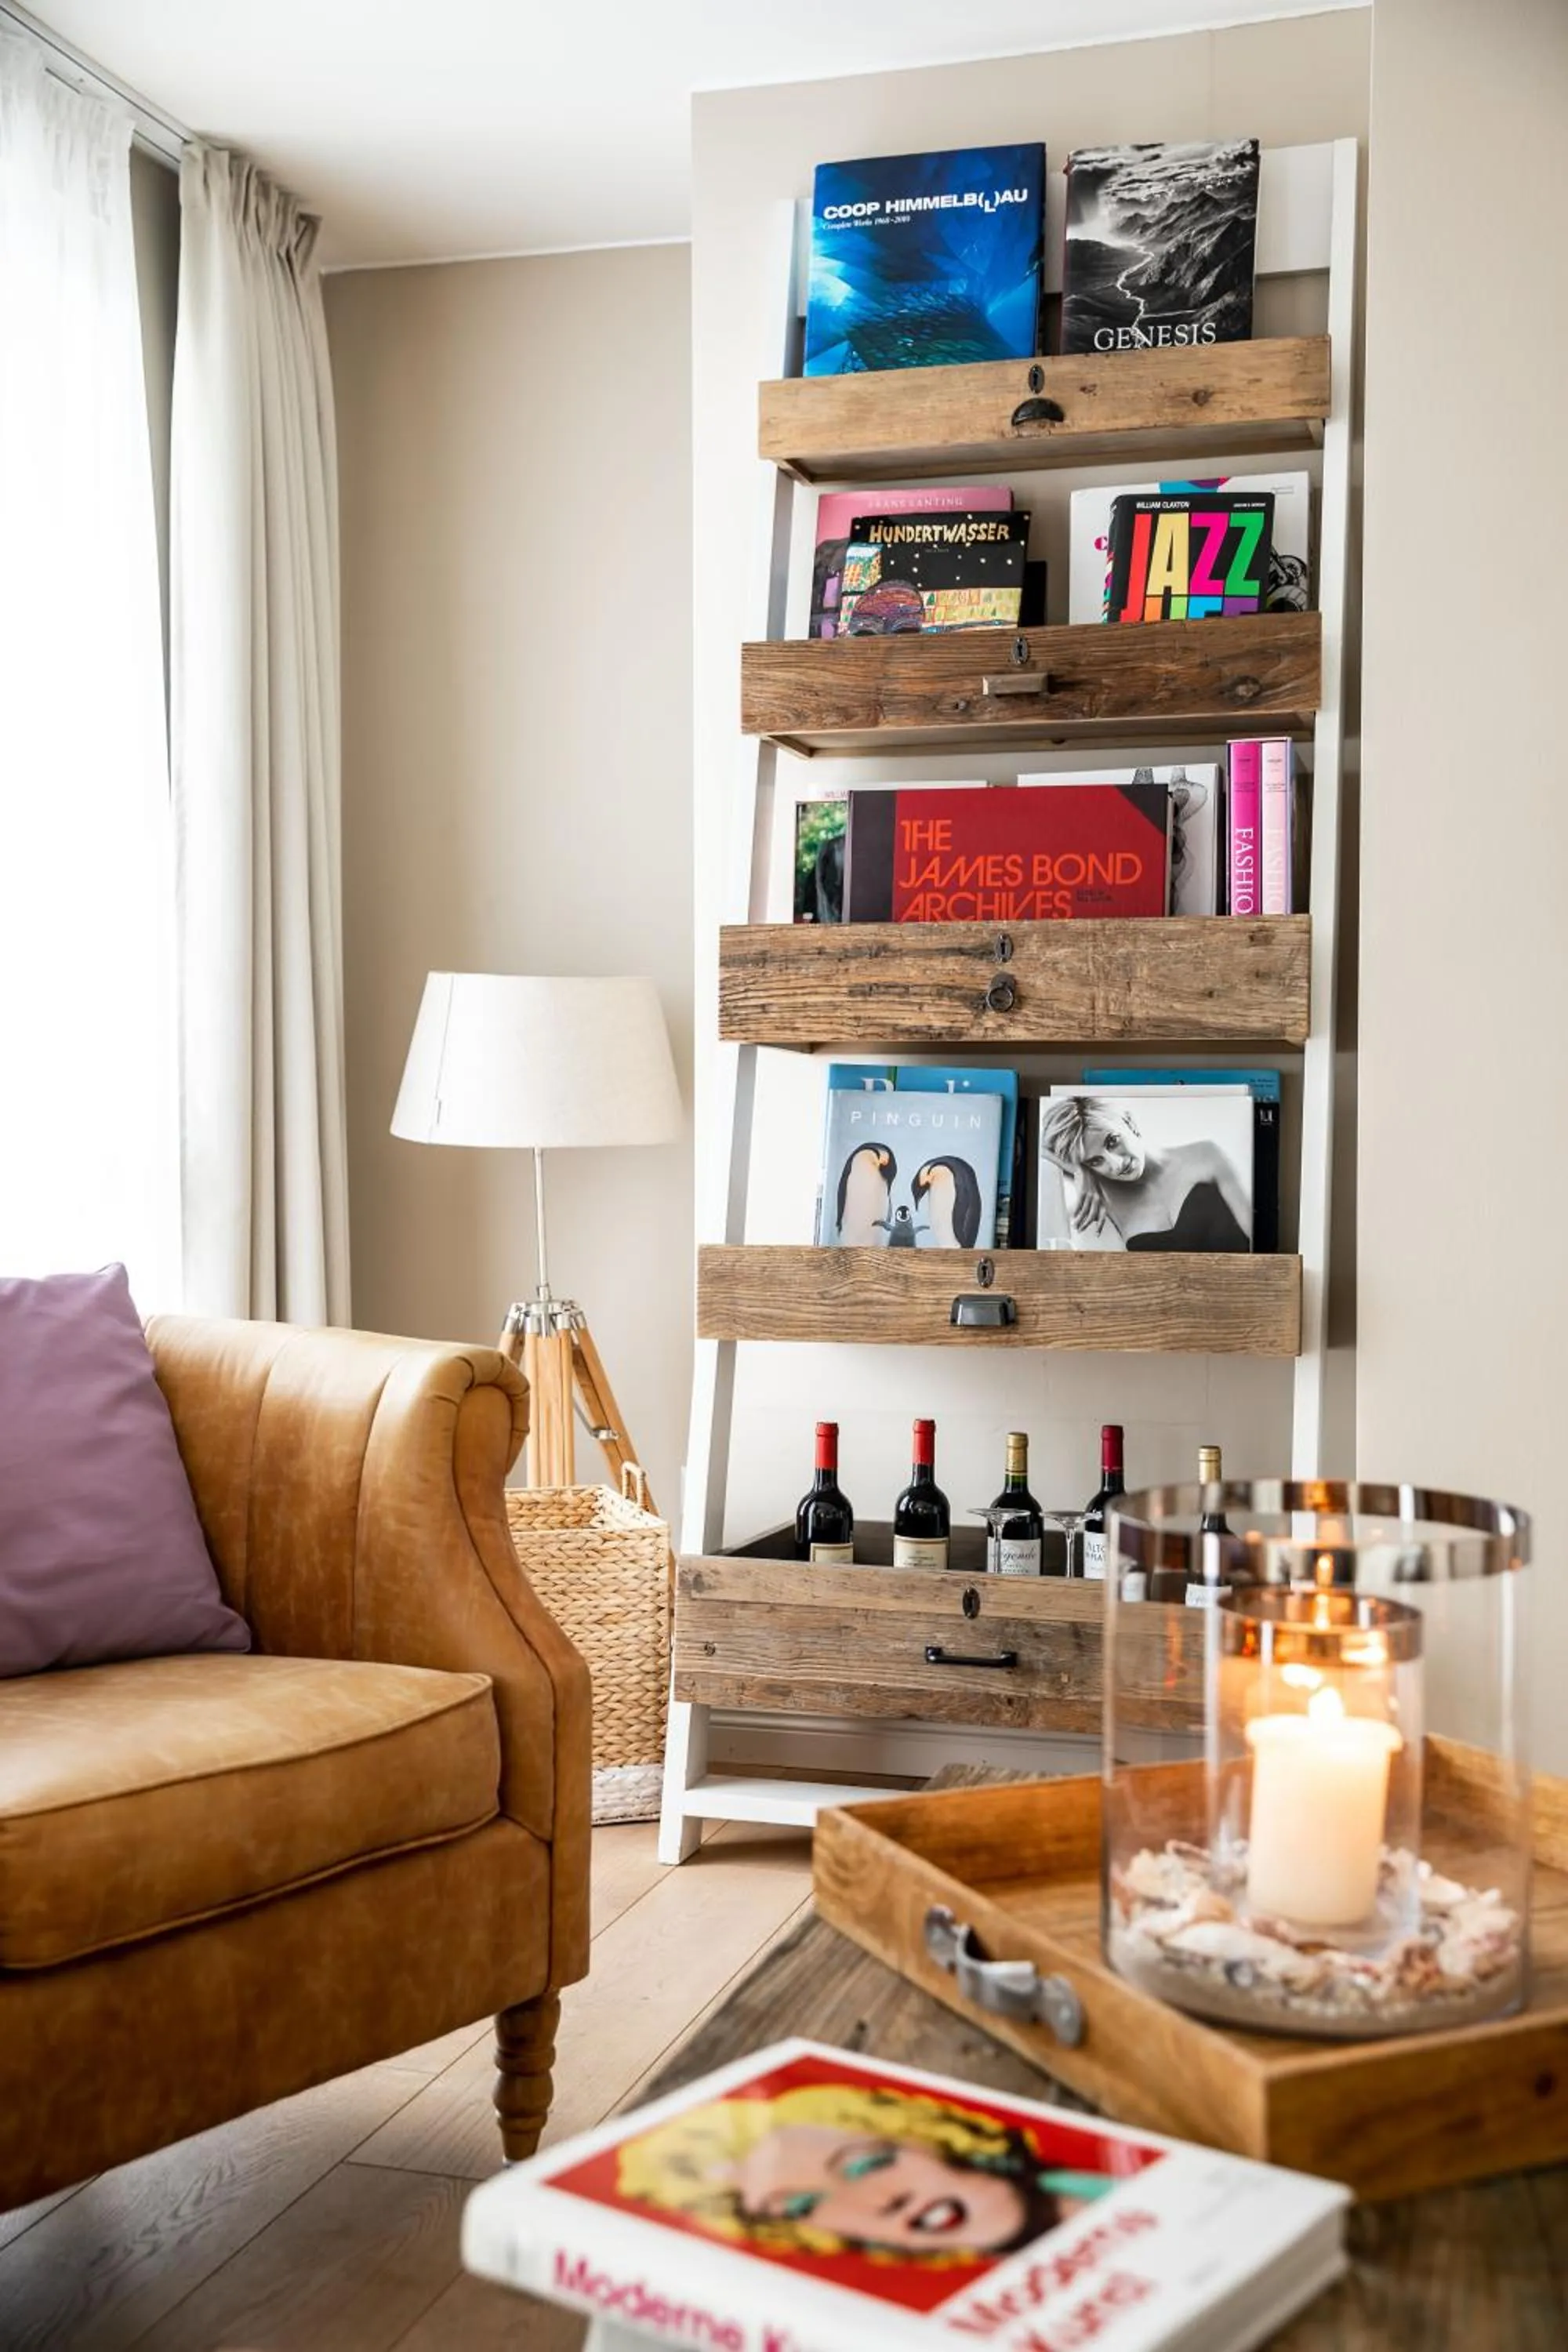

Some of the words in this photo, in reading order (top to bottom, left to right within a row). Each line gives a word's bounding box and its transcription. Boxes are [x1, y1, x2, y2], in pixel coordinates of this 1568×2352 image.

[823, 201, 880, 220] COOP
[885, 188, 1029, 214] HIMMELB(L)AU
[1094, 322, 1216, 350] GENESIS
[869, 522, 1010, 543] HUNDERTWASSER
[1120, 512, 1265, 623] JAZZ
[901, 819, 953, 851] THE
[899, 855, 1023, 888] JAMES
[1033, 852, 1142, 886] BOND
[902, 891, 1073, 921] ARCHIVES
[851, 1111, 980, 1129] PINGUIN
